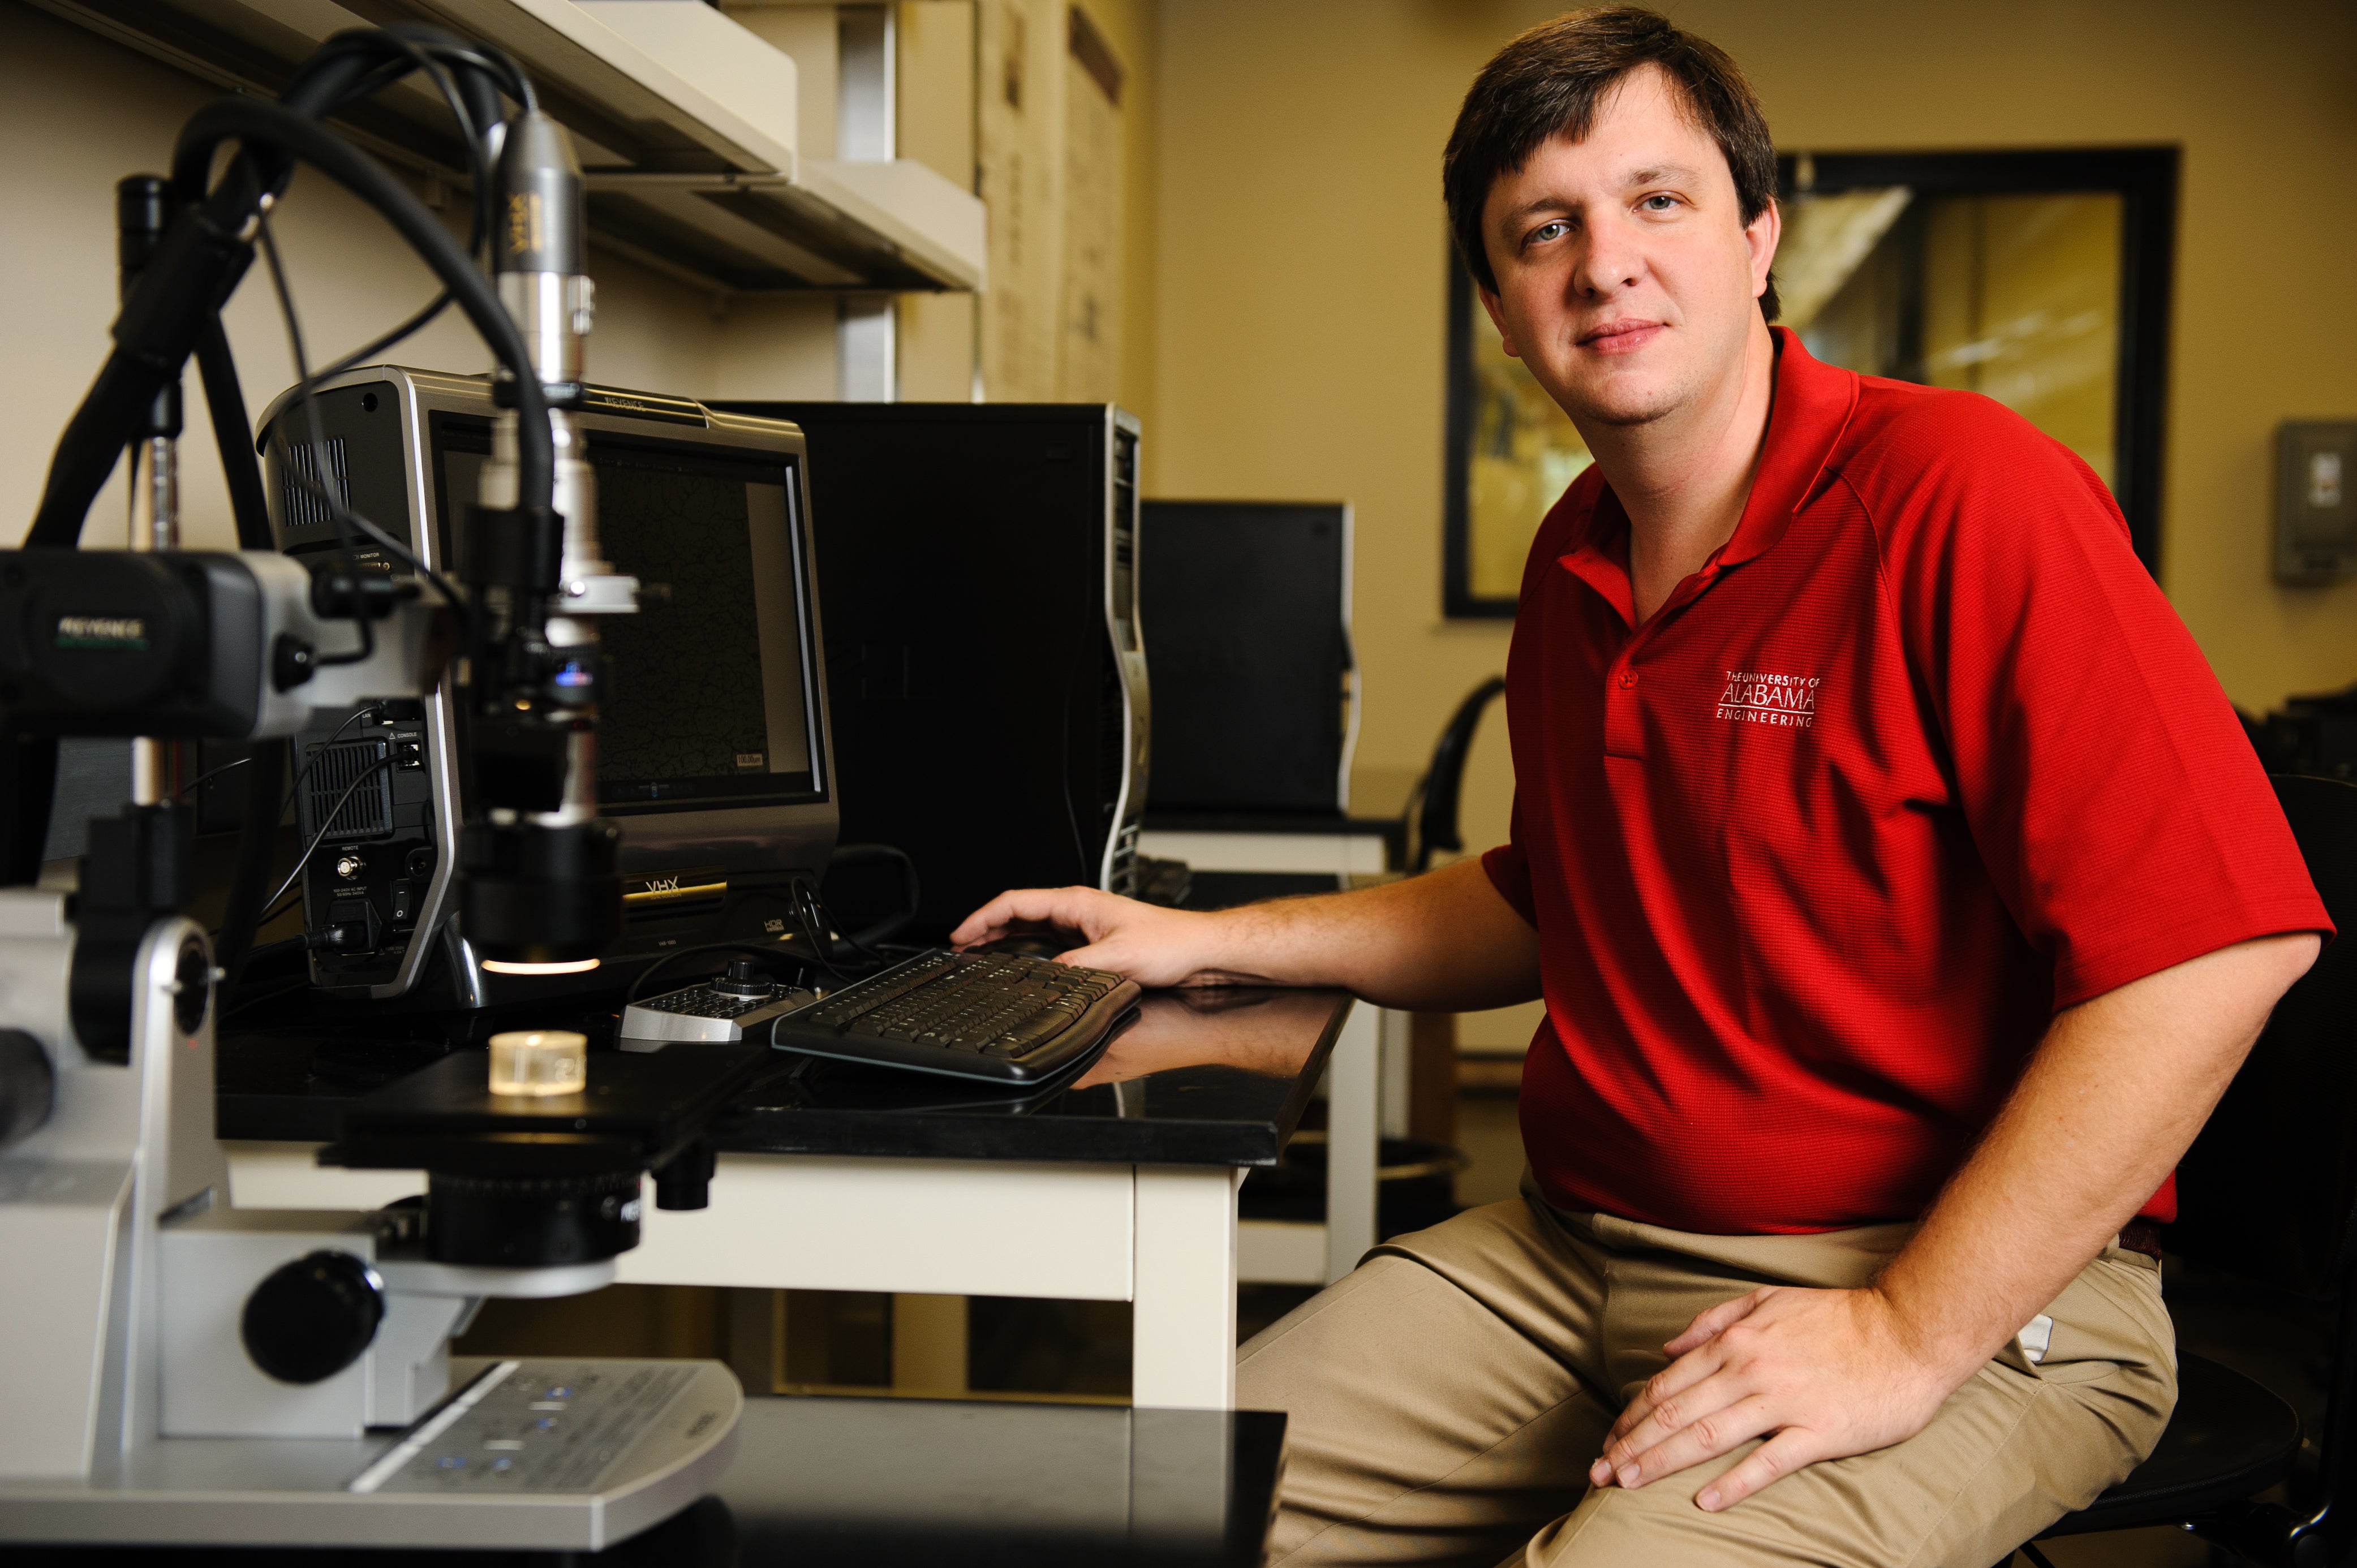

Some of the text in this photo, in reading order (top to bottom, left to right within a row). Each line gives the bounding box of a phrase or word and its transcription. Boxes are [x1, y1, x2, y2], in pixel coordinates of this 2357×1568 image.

[1726, 670, 1820, 688] THE UNIVERSITY OF
[1720, 682, 1815, 710] ALABAMA
[1716, 708, 1813, 727] ENGINEERING
[645, 875, 680, 894] VHX
[764, 918, 783, 929] HDR
